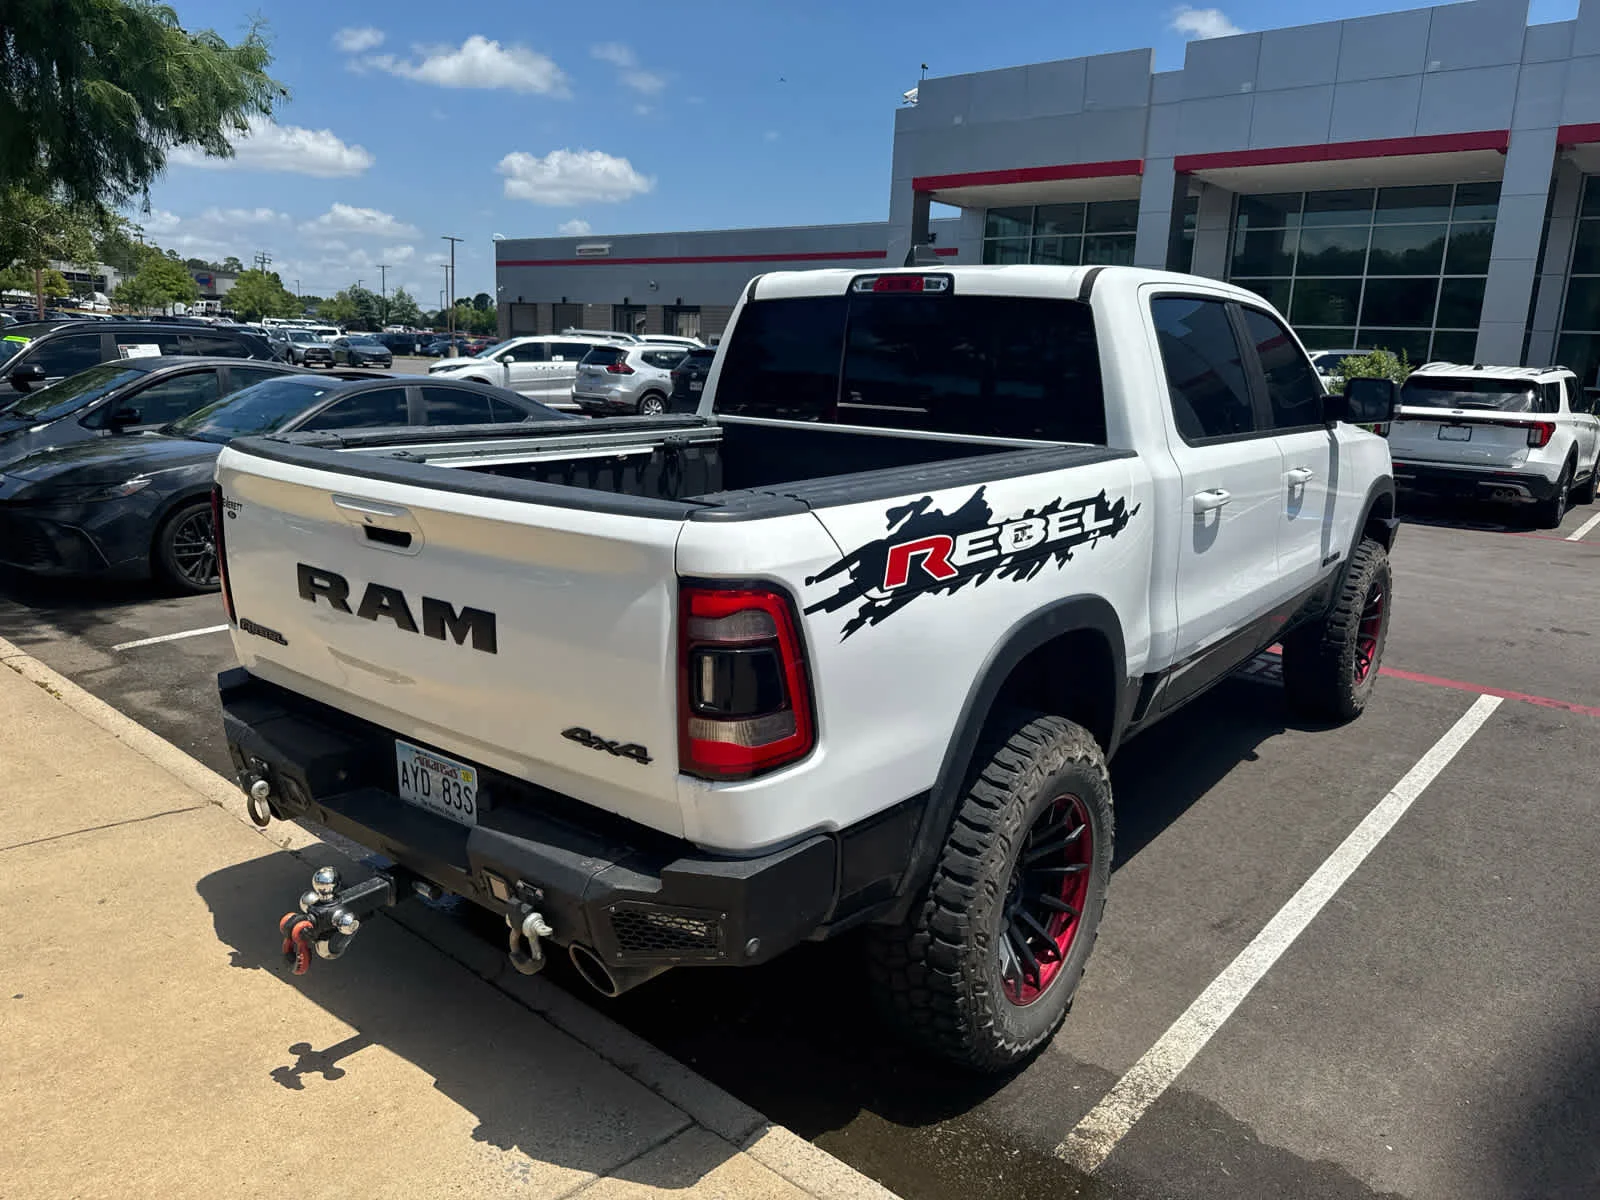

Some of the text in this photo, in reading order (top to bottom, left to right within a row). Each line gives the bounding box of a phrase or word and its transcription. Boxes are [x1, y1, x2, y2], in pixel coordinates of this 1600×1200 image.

[883, 504, 1115, 590] REBEL
[297, 562, 498, 655] RAM
[401, 761, 474, 815] AYD 83S
